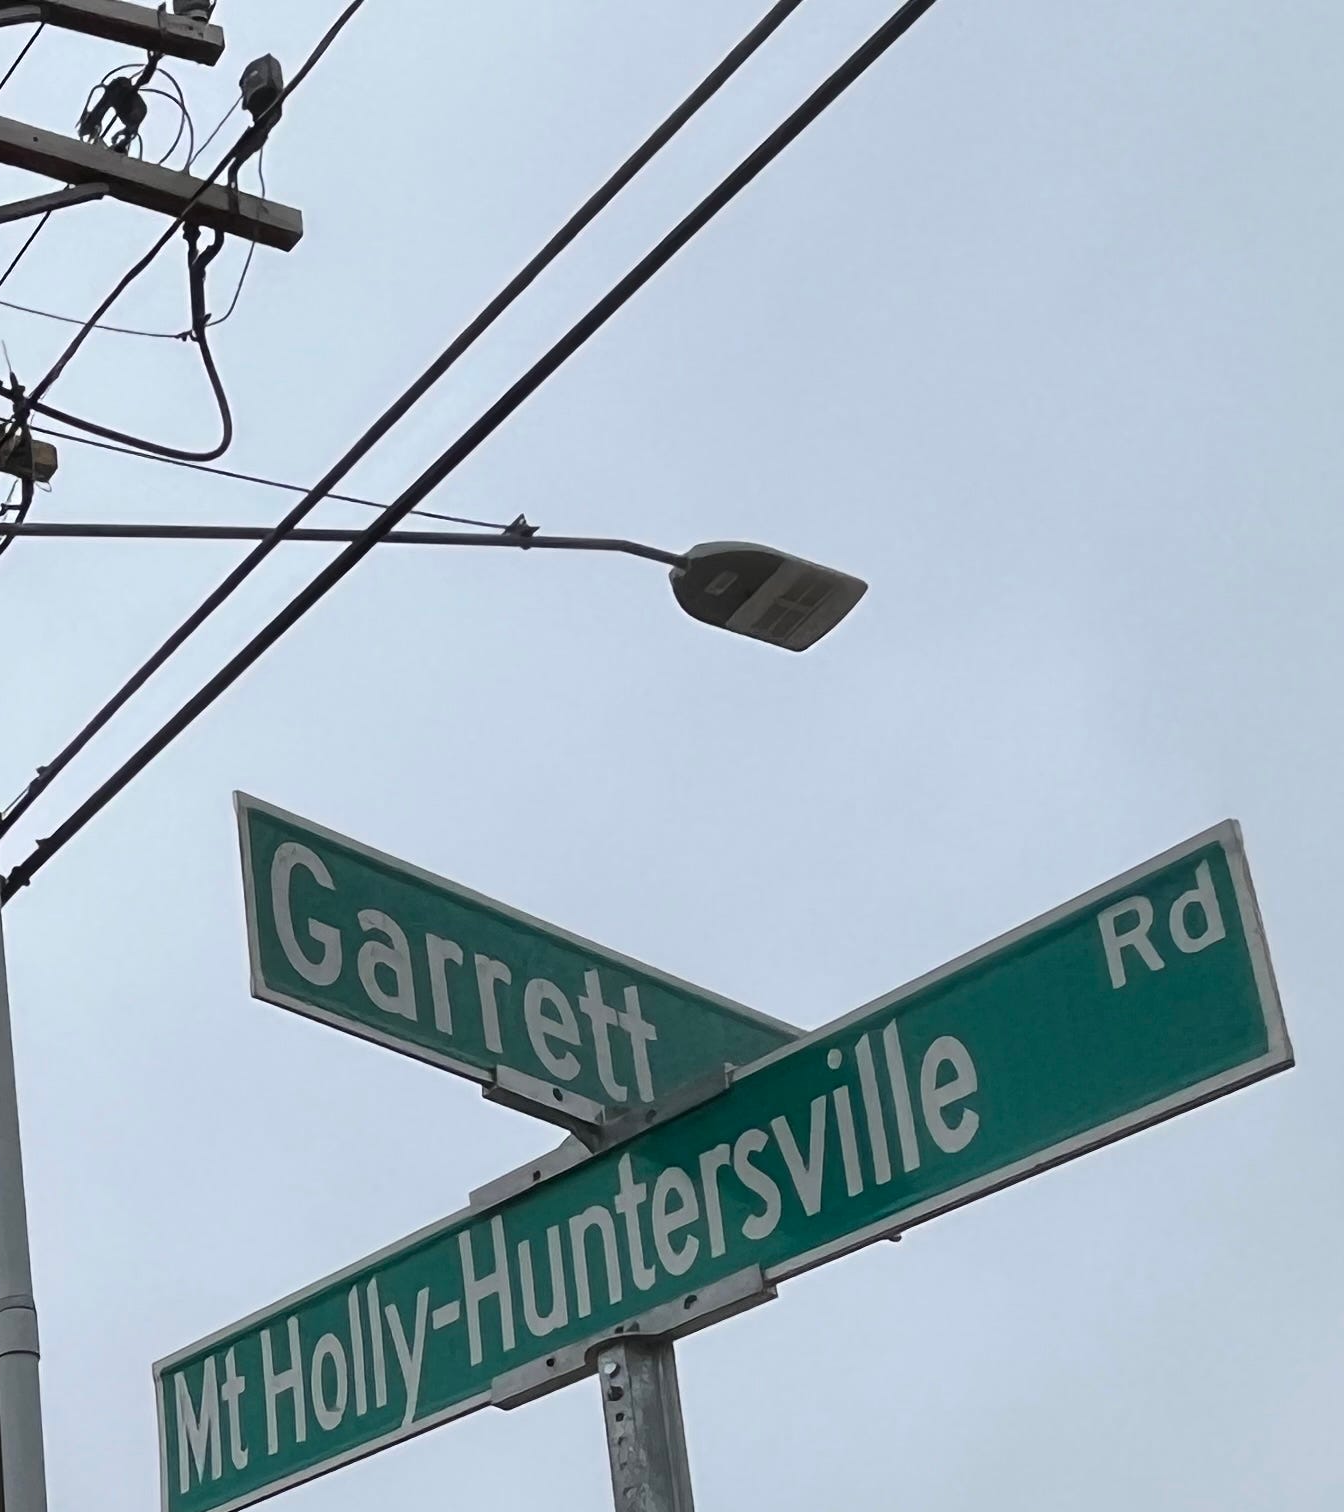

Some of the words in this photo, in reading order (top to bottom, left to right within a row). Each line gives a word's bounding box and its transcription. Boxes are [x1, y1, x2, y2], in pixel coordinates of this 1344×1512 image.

[172, 1346, 250, 1495] Mt
[259, 1018, 981, 1457] Holly-Huntersville
[1097, 860, 1227, 989] Rd
[269, 841, 659, 1104] Garrett
